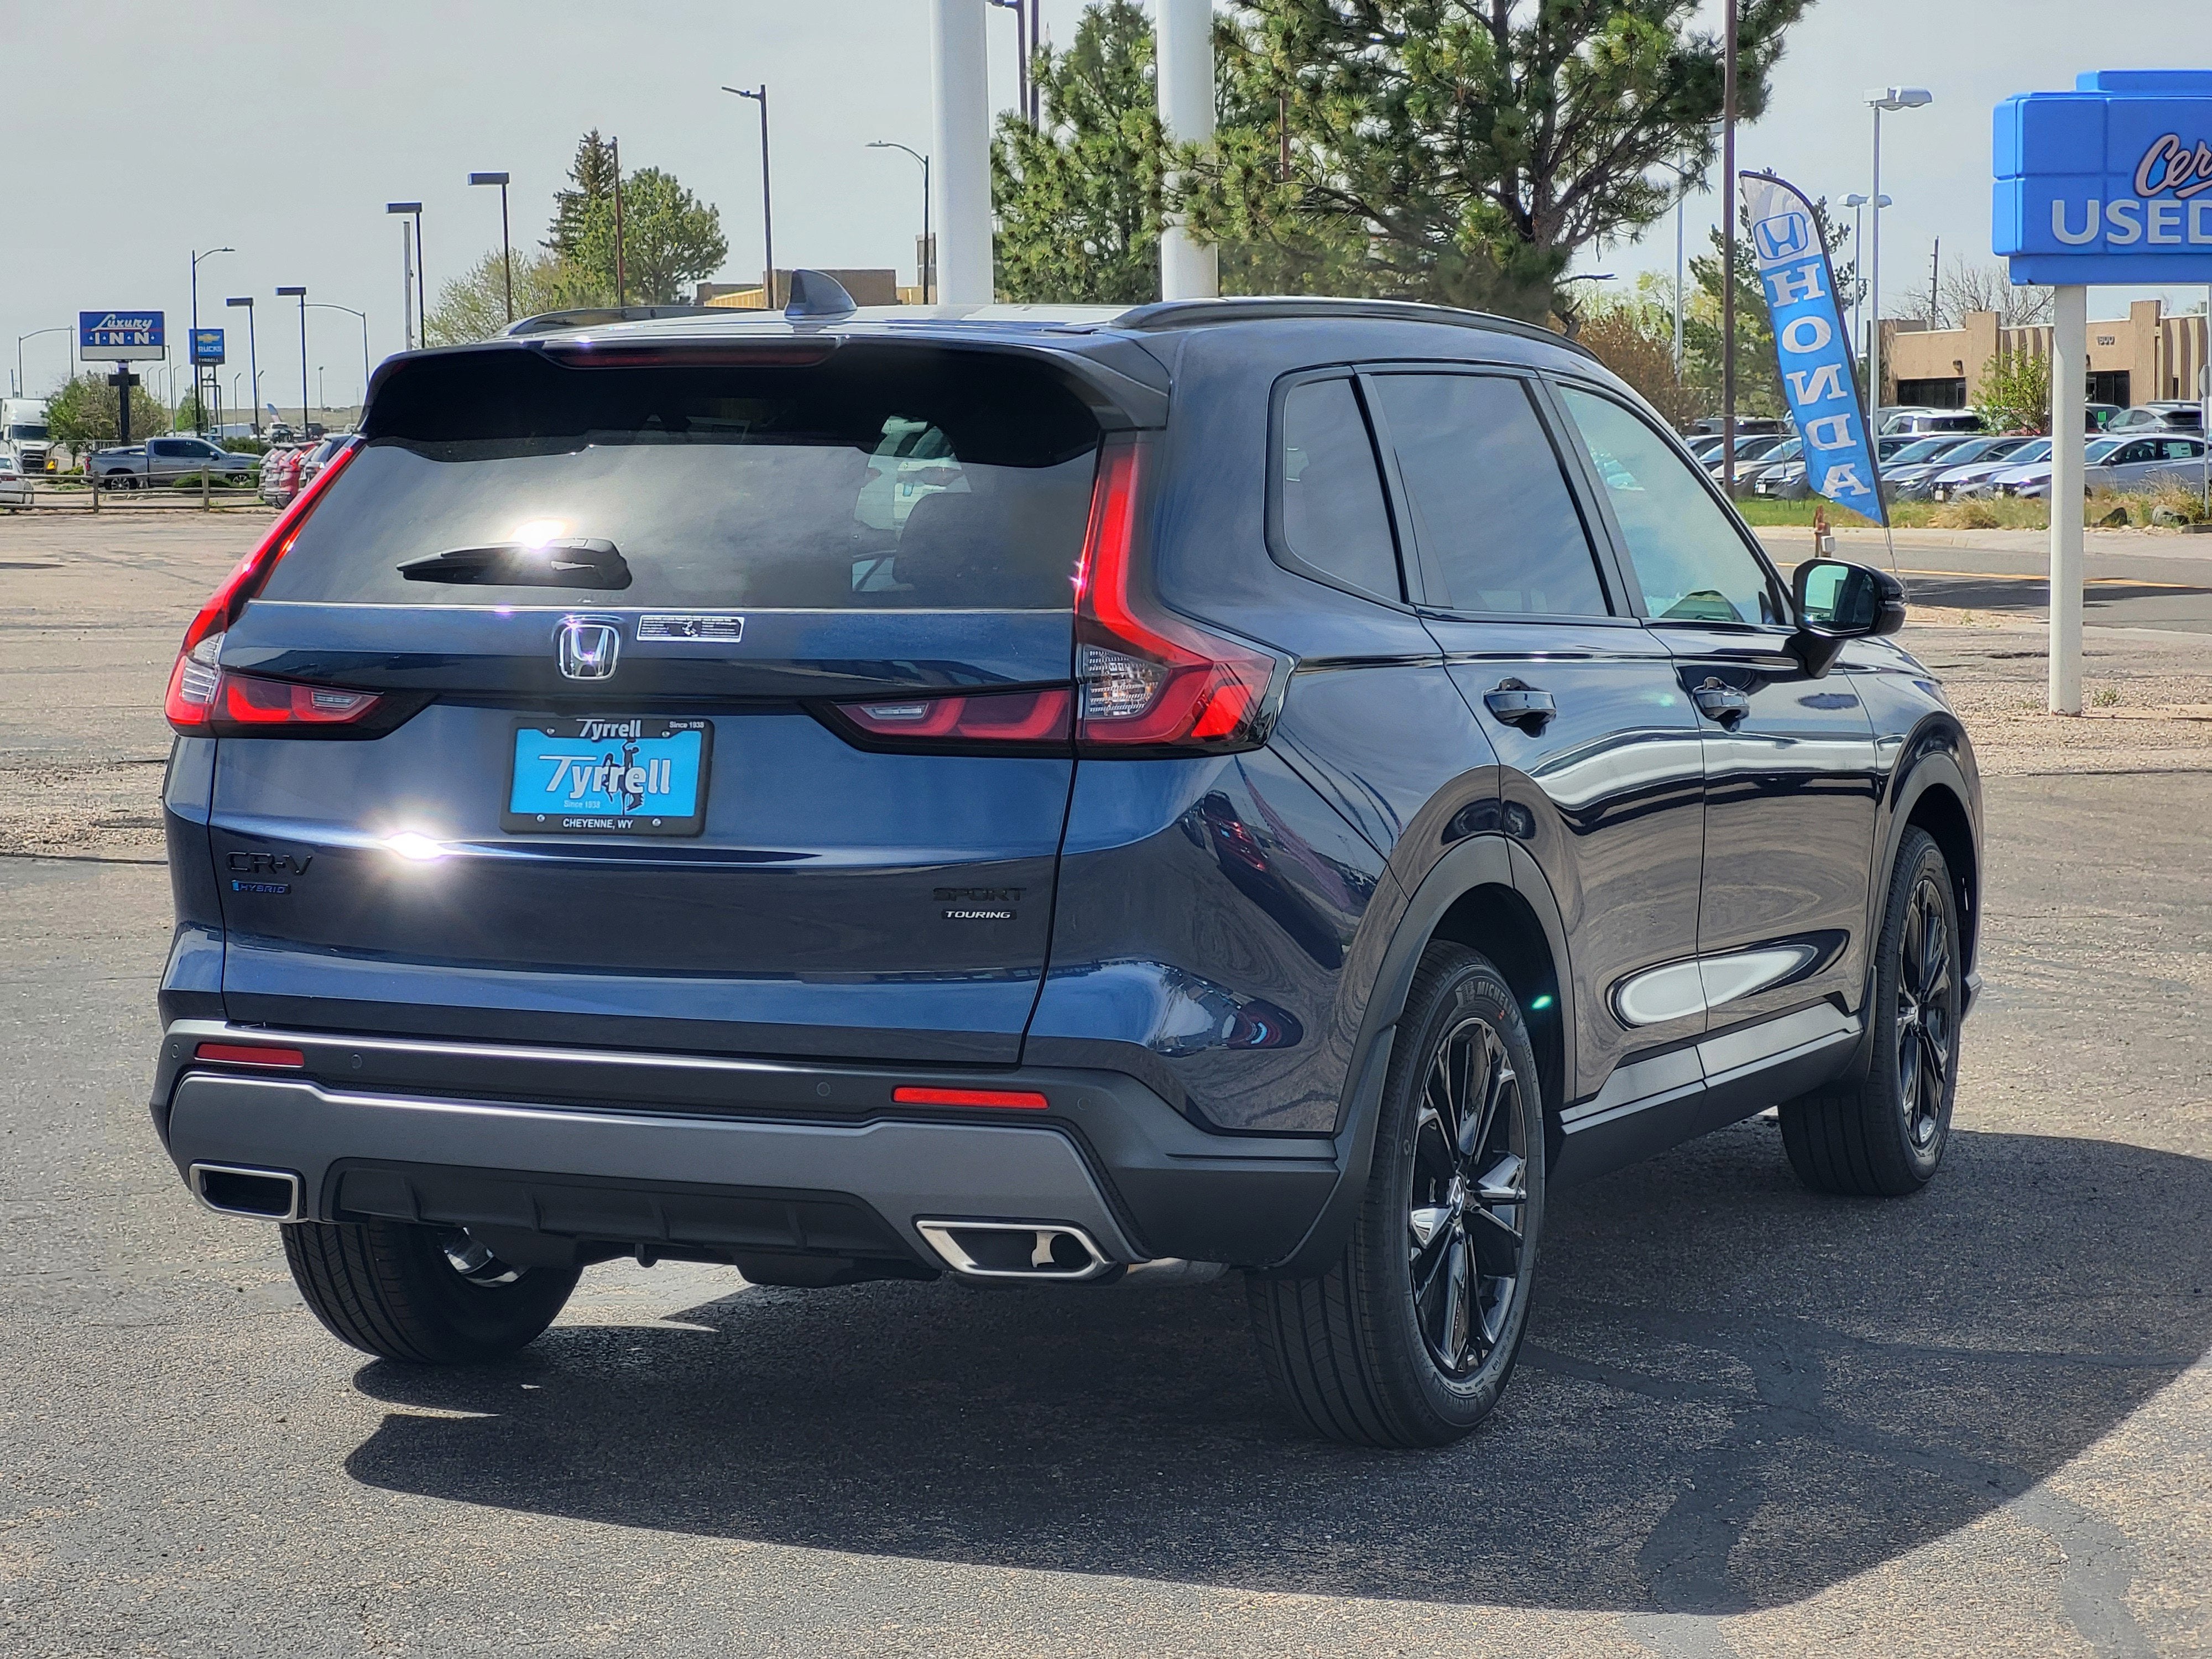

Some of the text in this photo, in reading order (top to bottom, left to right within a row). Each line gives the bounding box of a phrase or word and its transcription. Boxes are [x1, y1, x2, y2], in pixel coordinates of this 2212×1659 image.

[2052, 199, 2212, 244] USED
[91, 314, 153, 332] Luxury
[95, 332, 149, 345] INN
[576, 718, 641, 740] Tyrrell
[539, 755, 671, 799] Tyrrell
[564, 800, 583, 808] Since
[563, 818, 634, 830] CHEYENNE, WY
[226, 852, 312, 876] CR-V
[240, 884, 286, 894] HYBRID
[933, 887, 1027, 901] SPORT
